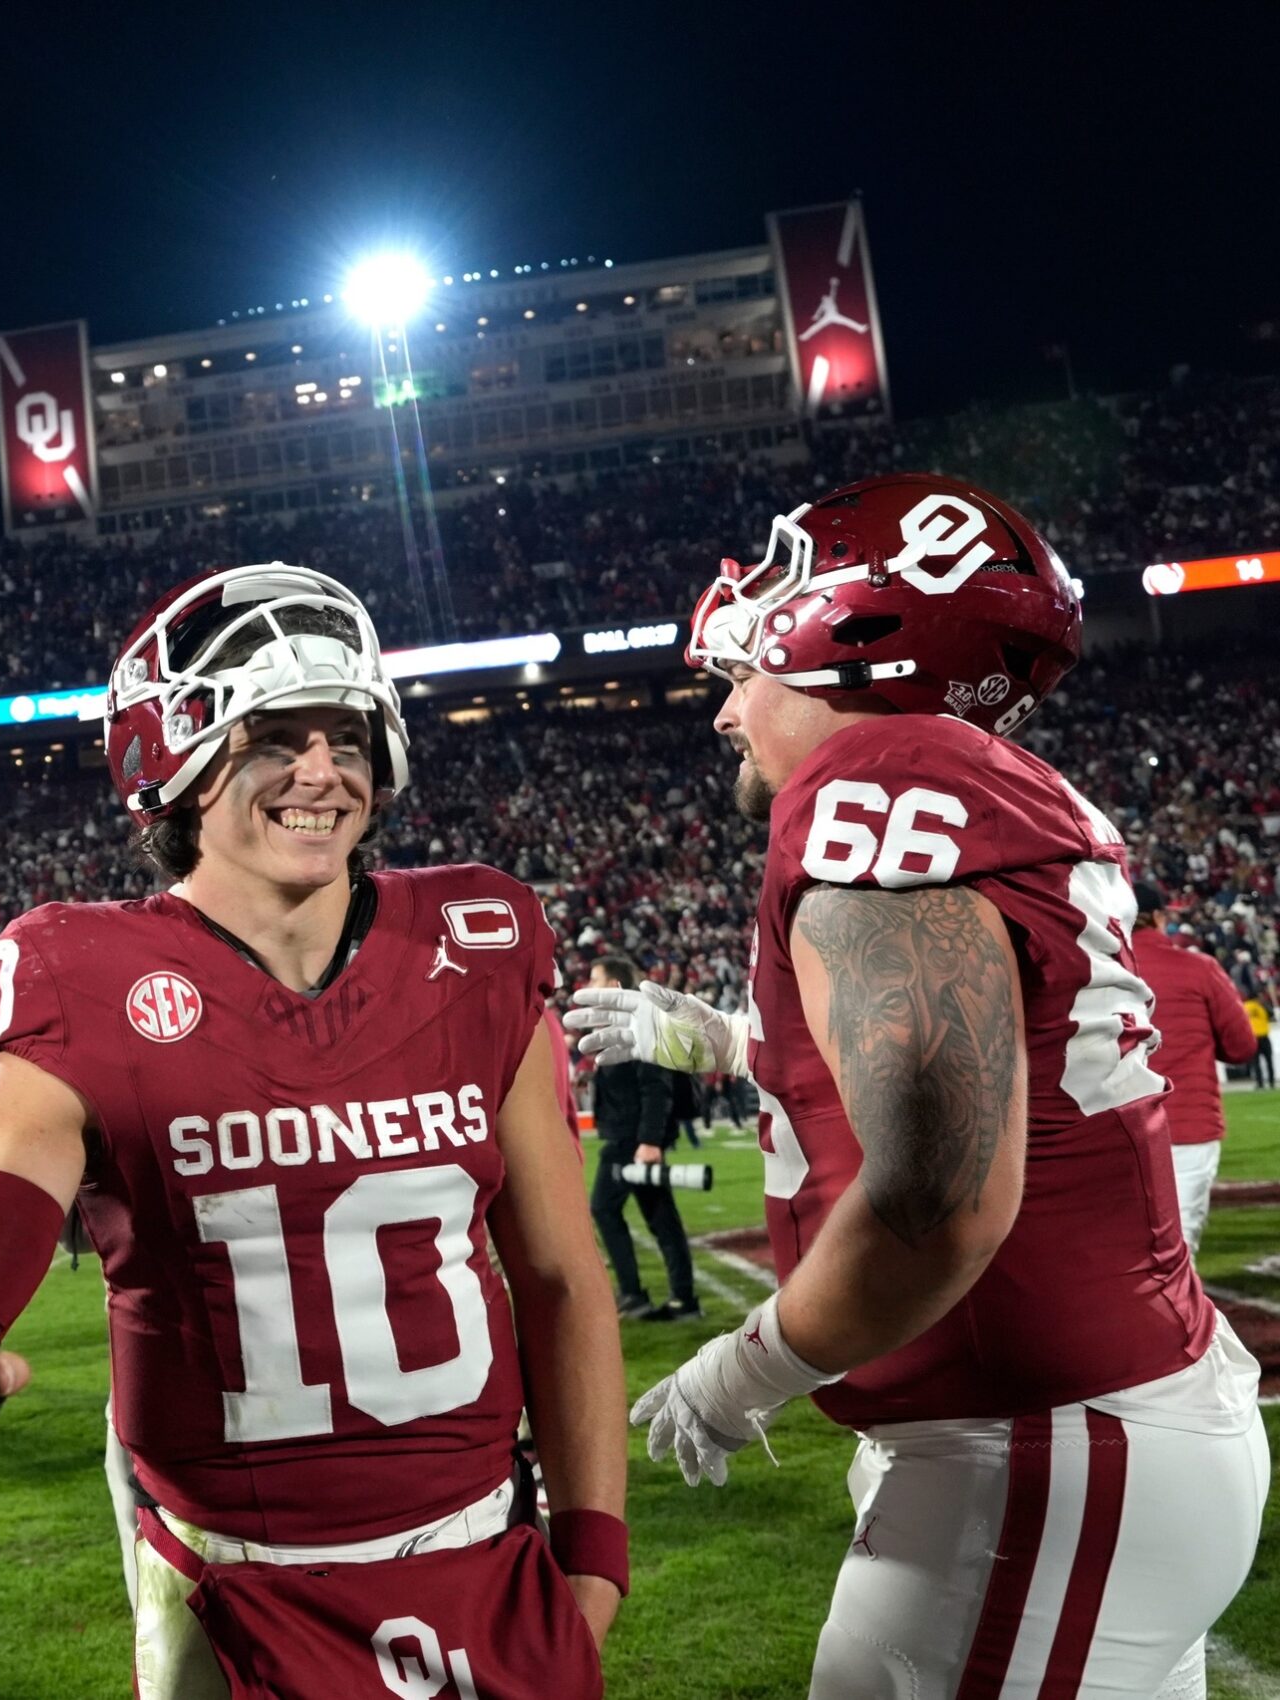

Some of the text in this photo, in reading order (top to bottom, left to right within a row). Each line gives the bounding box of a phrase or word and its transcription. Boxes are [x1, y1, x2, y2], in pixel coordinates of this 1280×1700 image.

[15, 391, 76, 463] OU
[898, 494, 996, 595] OU
[994, 694, 1037, 736] 6
[801, 779, 970, 890] 66
[446, 902, 514, 944] C
[131, 976, 197, 1038] SEC
[169, 1084, 489, 1177] SOONERS
[192, 1164, 494, 1443] 10
